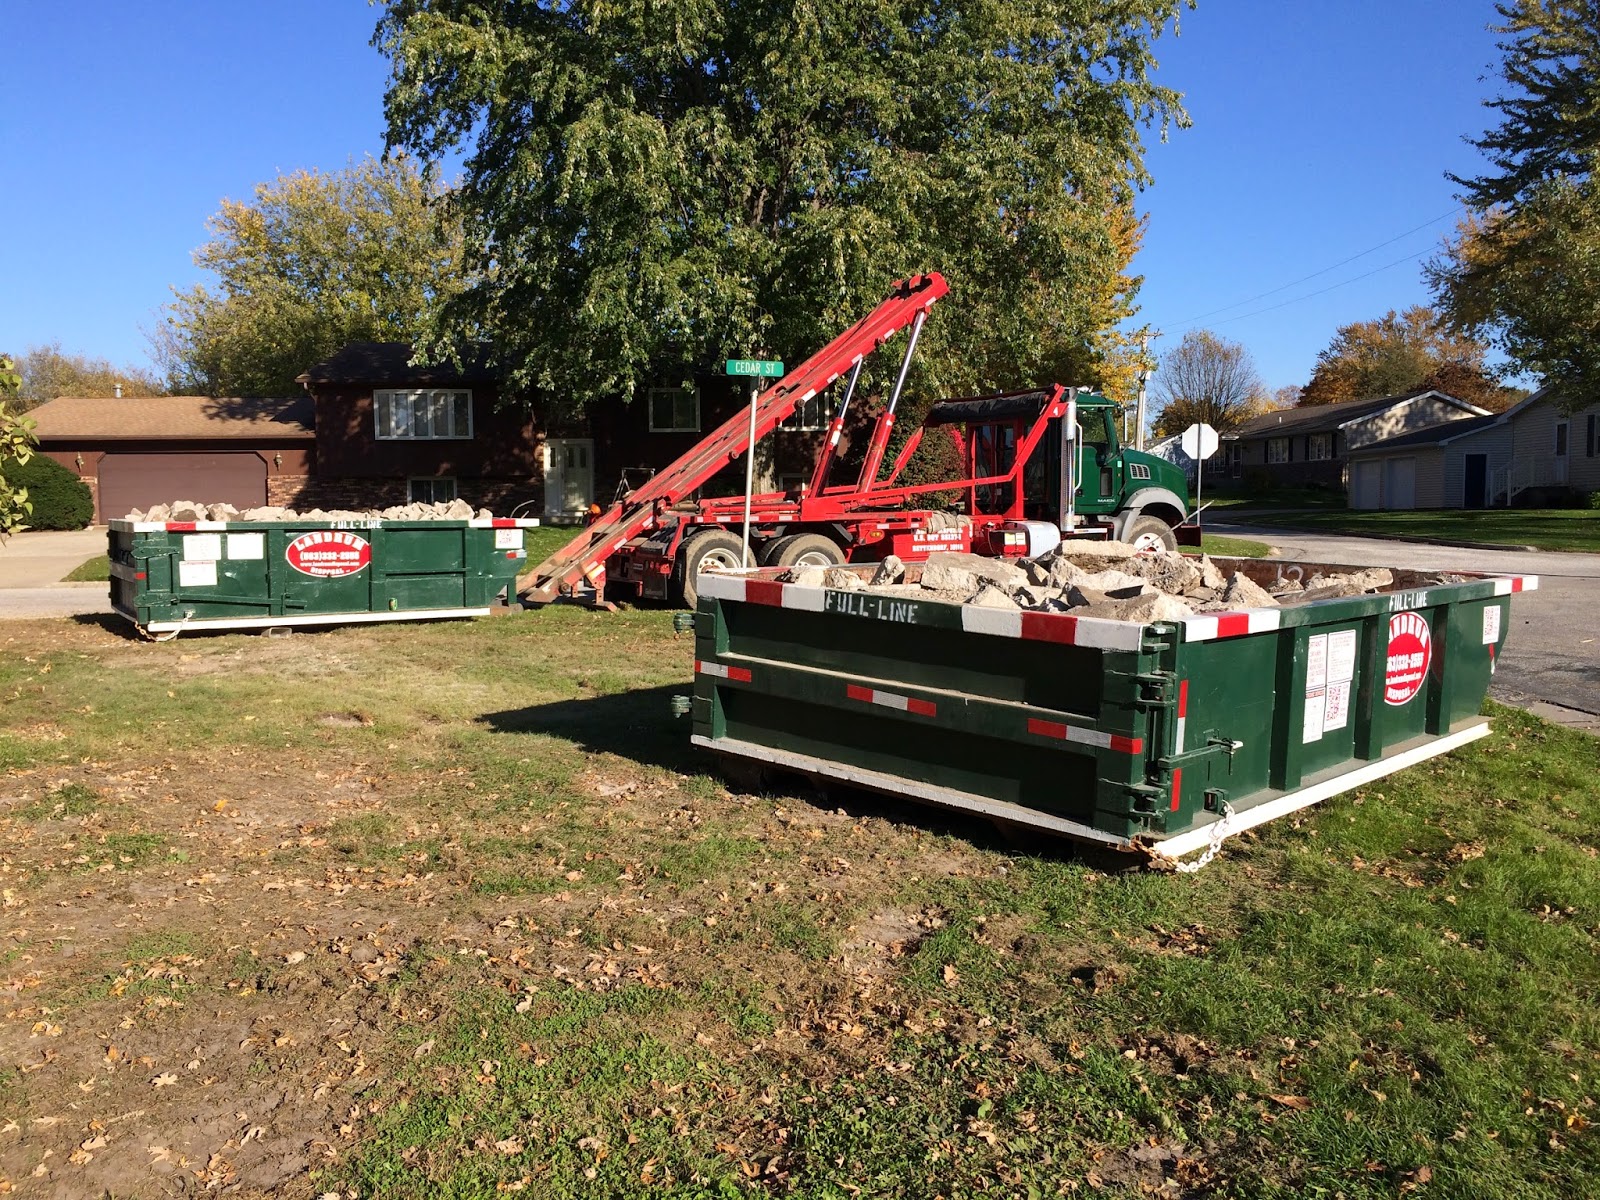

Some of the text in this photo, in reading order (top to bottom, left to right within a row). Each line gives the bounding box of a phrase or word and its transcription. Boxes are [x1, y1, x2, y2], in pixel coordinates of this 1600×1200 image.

[735, 361, 775, 374] CEDAR ST
[293, 531, 366, 551] LANDRUM
[825, 590, 918, 623] FULL-LINE
[1389, 591, 1428, 611] FULL-LINE
[1389, 615, 1429, 649] ANDRUM
